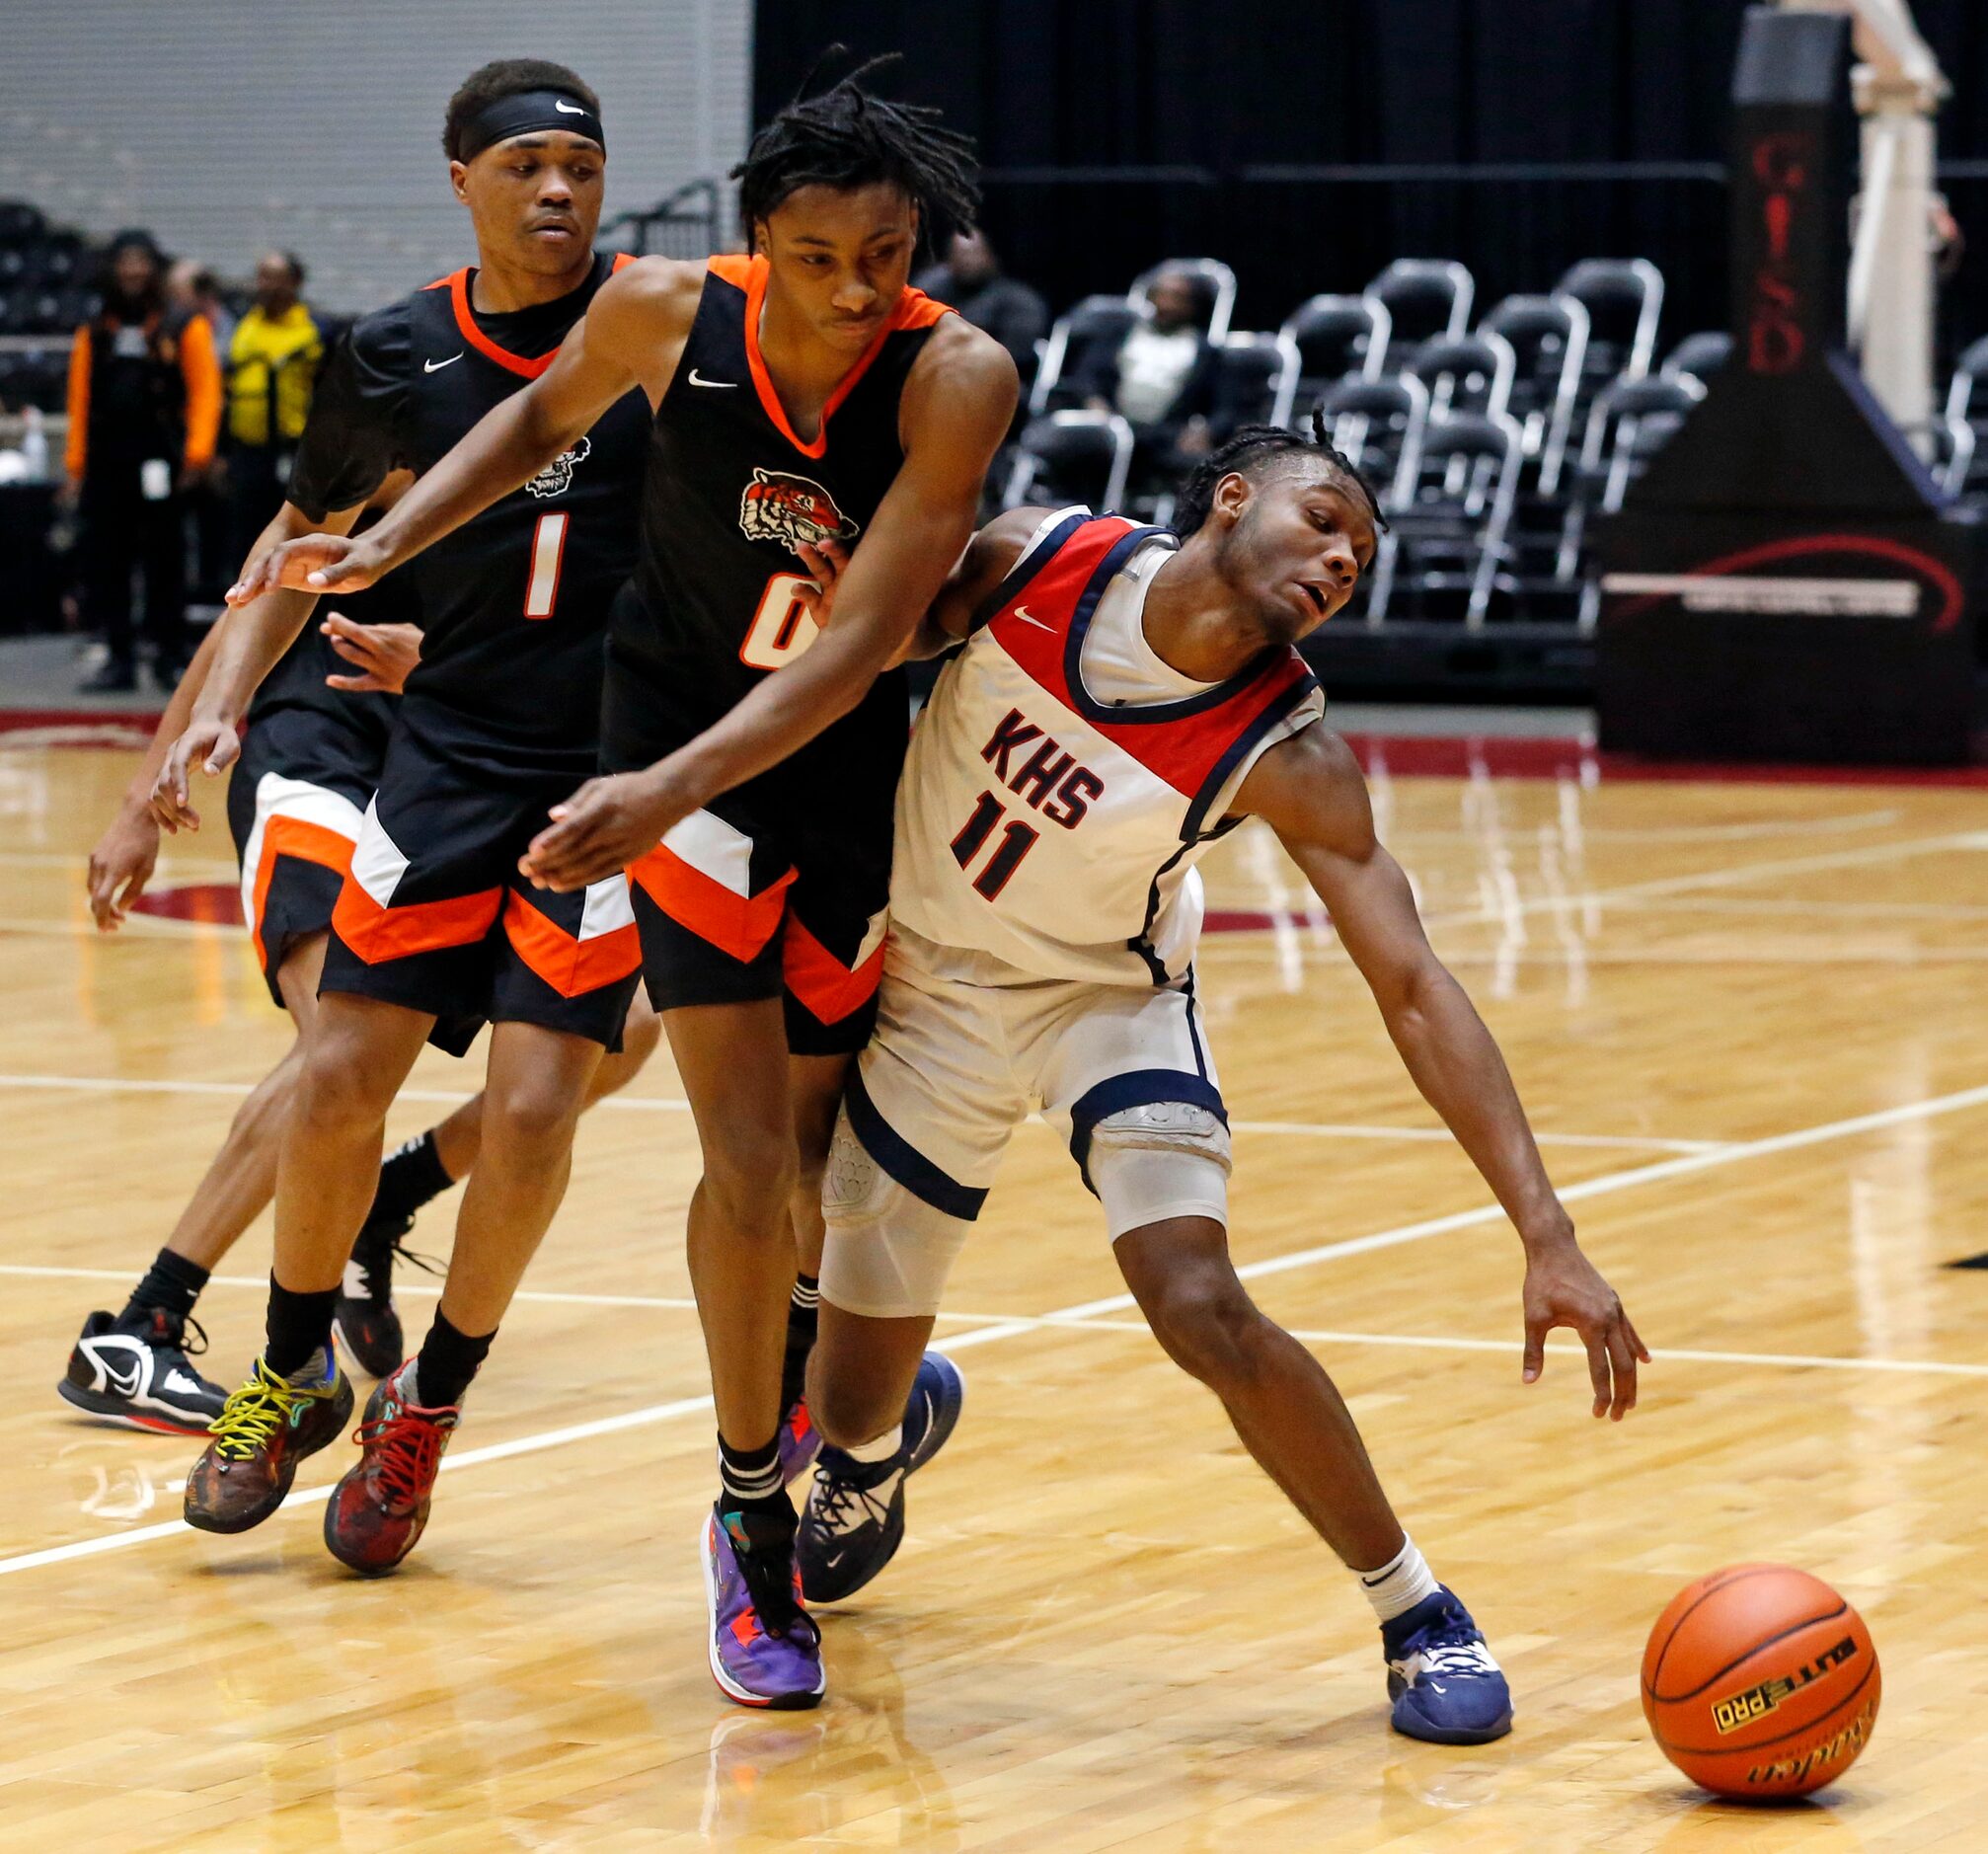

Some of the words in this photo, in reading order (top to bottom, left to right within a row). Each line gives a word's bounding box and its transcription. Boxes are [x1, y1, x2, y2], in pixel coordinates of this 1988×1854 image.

[523, 511, 570, 619] 1
[739, 572, 822, 671] 0
[980, 708, 1105, 830] KHS
[950, 790, 1040, 902] 11
[1715, 1690, 1767, 1729] PRO
